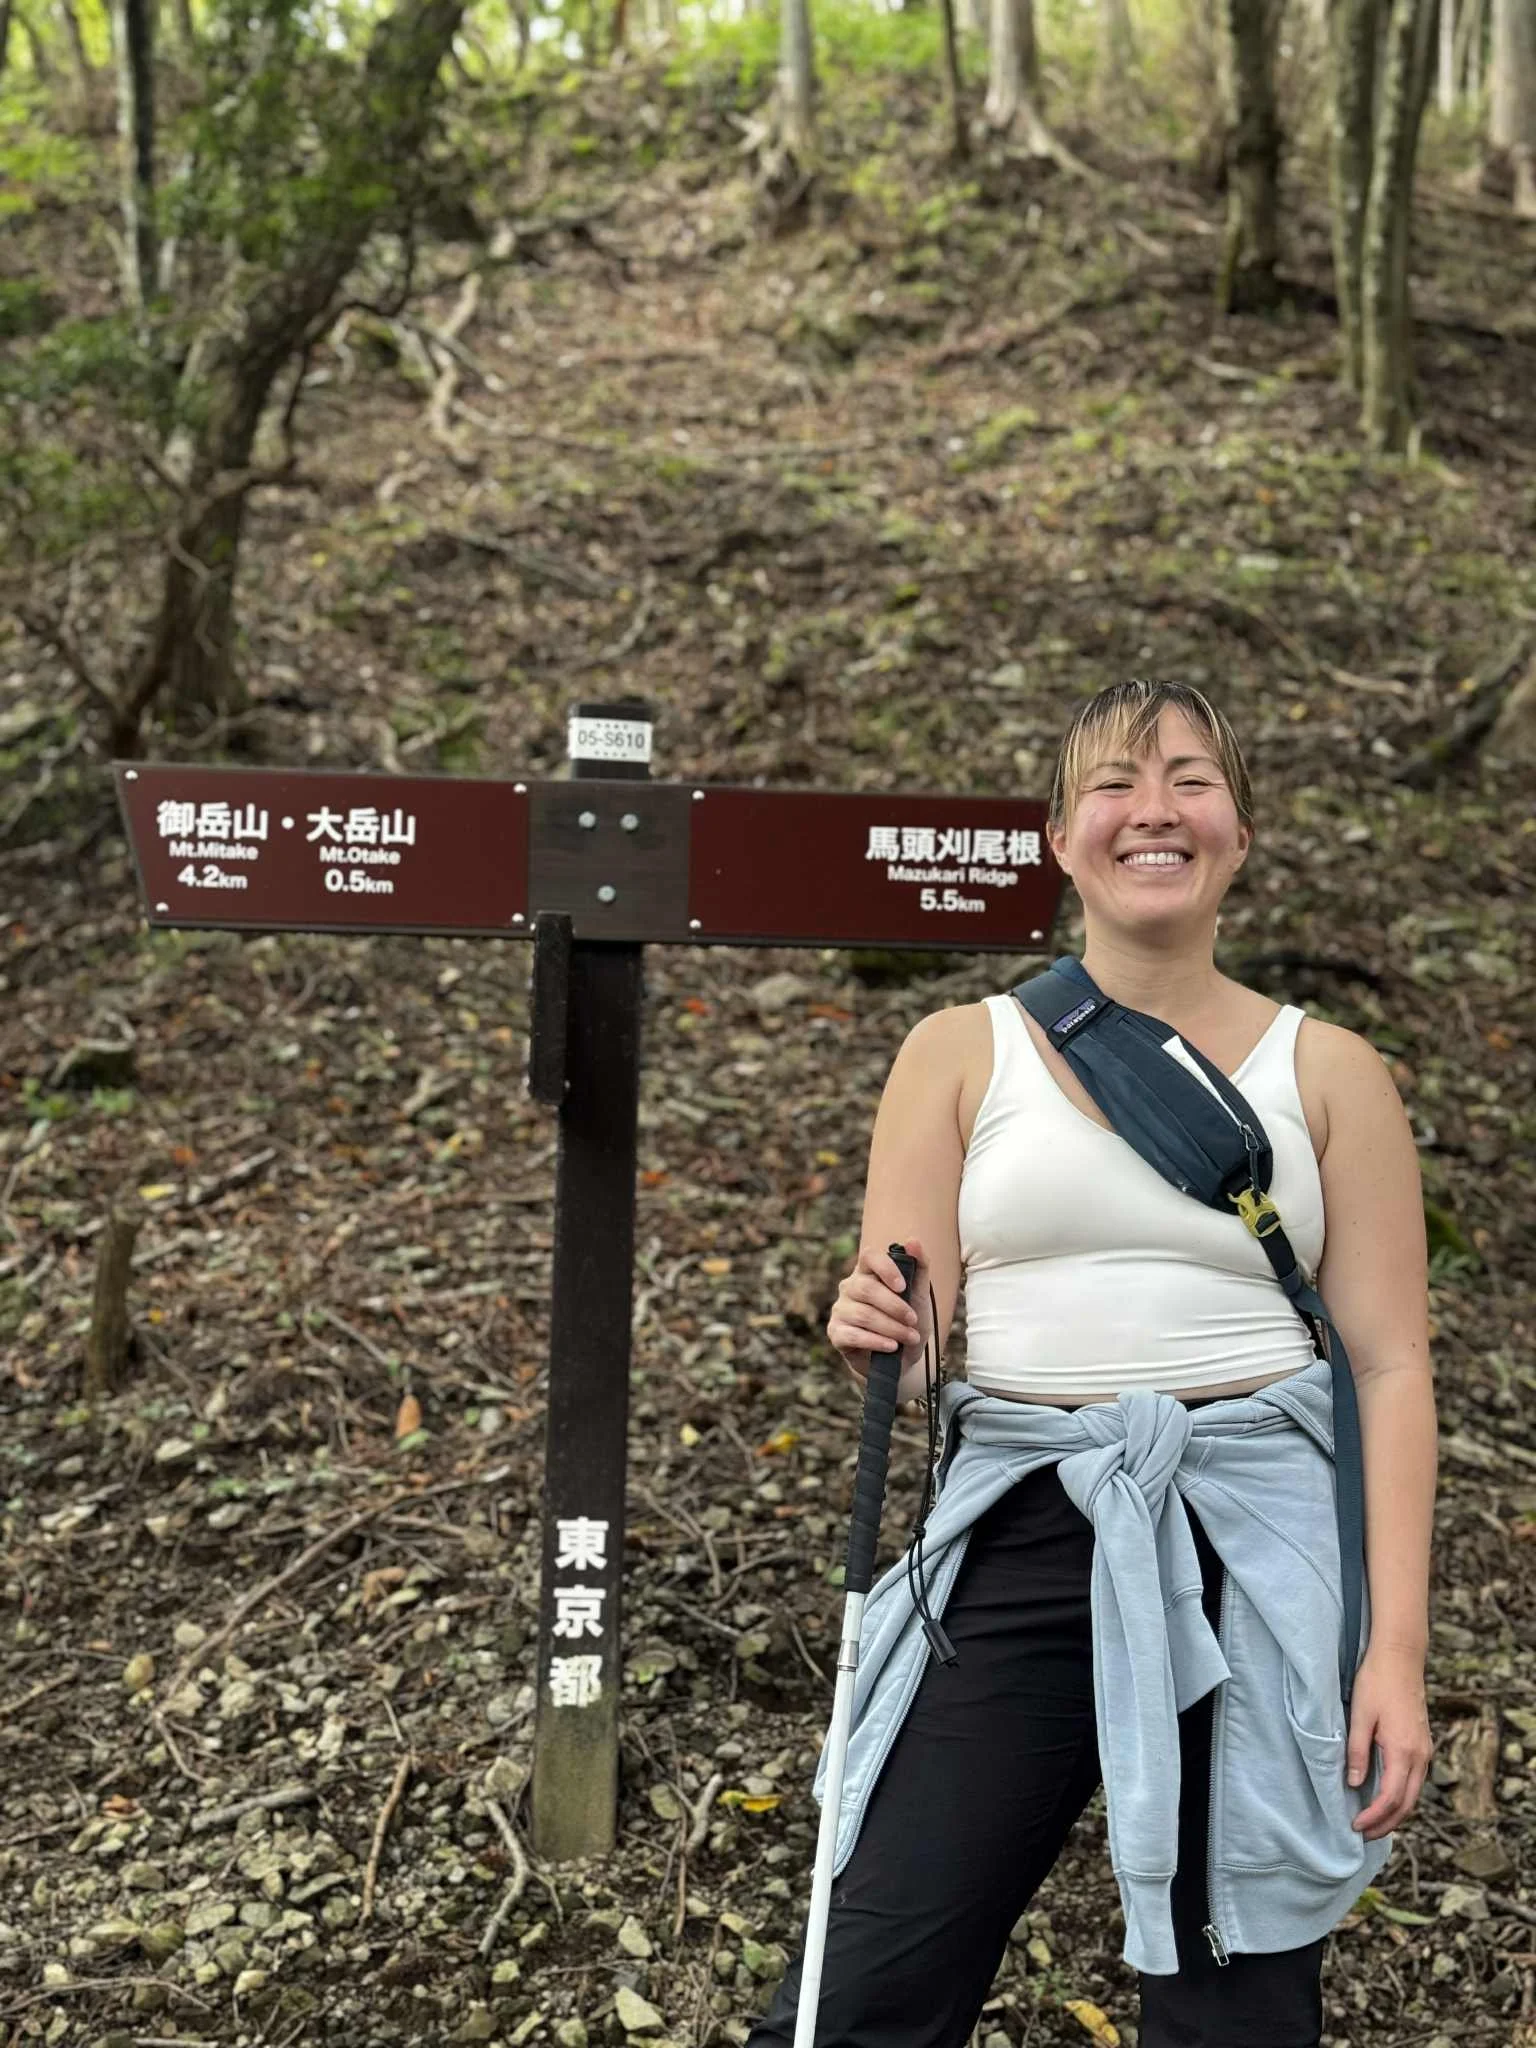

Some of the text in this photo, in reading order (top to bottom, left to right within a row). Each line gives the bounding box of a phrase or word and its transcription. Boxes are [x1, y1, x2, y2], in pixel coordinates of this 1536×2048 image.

[577, 729, 645, 749] 05-S610
[169, 840, 259, 860] Mt.Mitake
[320, 845, 401, 865] Mt.Otake
[865, 826, 1041, 866] 馬頭刈尾根
[177, 864, 248, 889] 4.2km
[325, 868, 394, 893] 0.5km
[968, 867, 1018, 888] Ridge
[920, 888, 986, 913] 5.5km
[549, 1516, 609, 1708] 東京都
